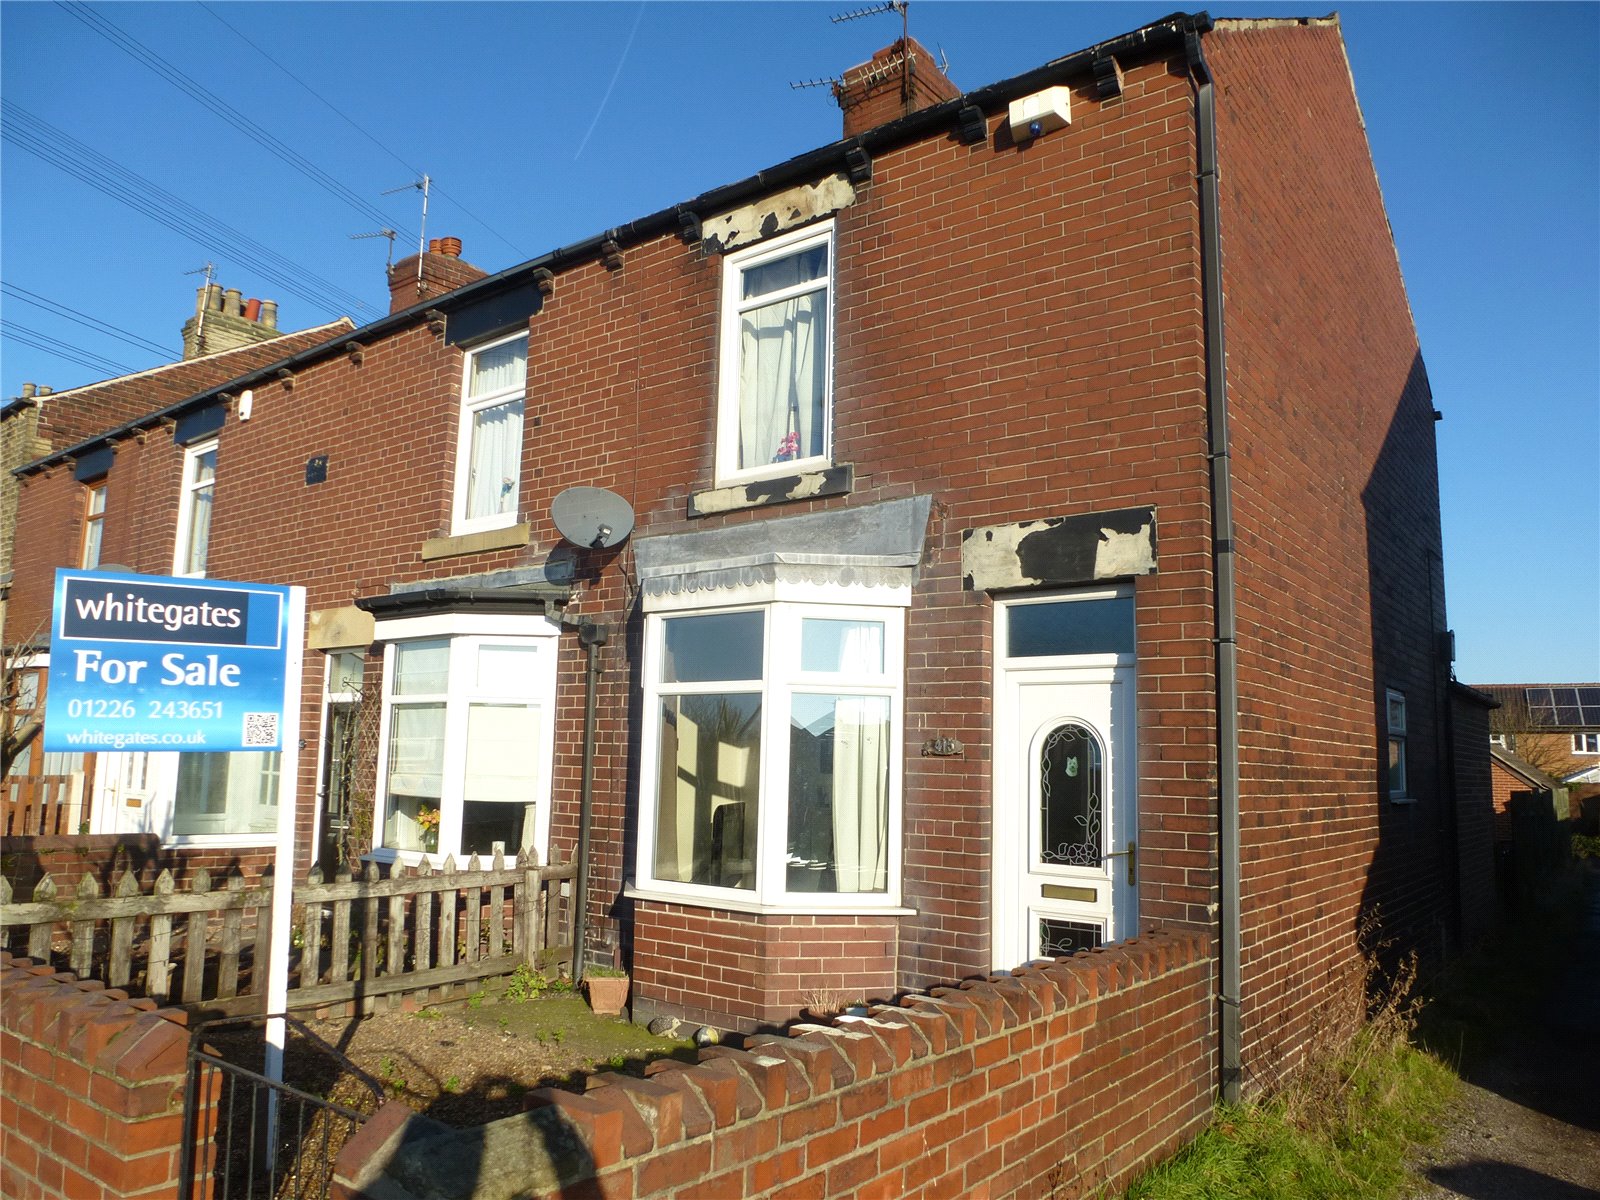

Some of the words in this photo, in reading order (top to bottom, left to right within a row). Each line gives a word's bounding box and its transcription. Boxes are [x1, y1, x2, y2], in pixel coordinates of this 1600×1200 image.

[75, 592, 241, 631] whitegates
[73, 649, 147, 684] For
[161, 653, 241, 687] Sale
[67, 699, 136, 719] 01226
[148, 700, 223, 720] 243651
[66, 729, 206, 749] whitegates.co.uk
